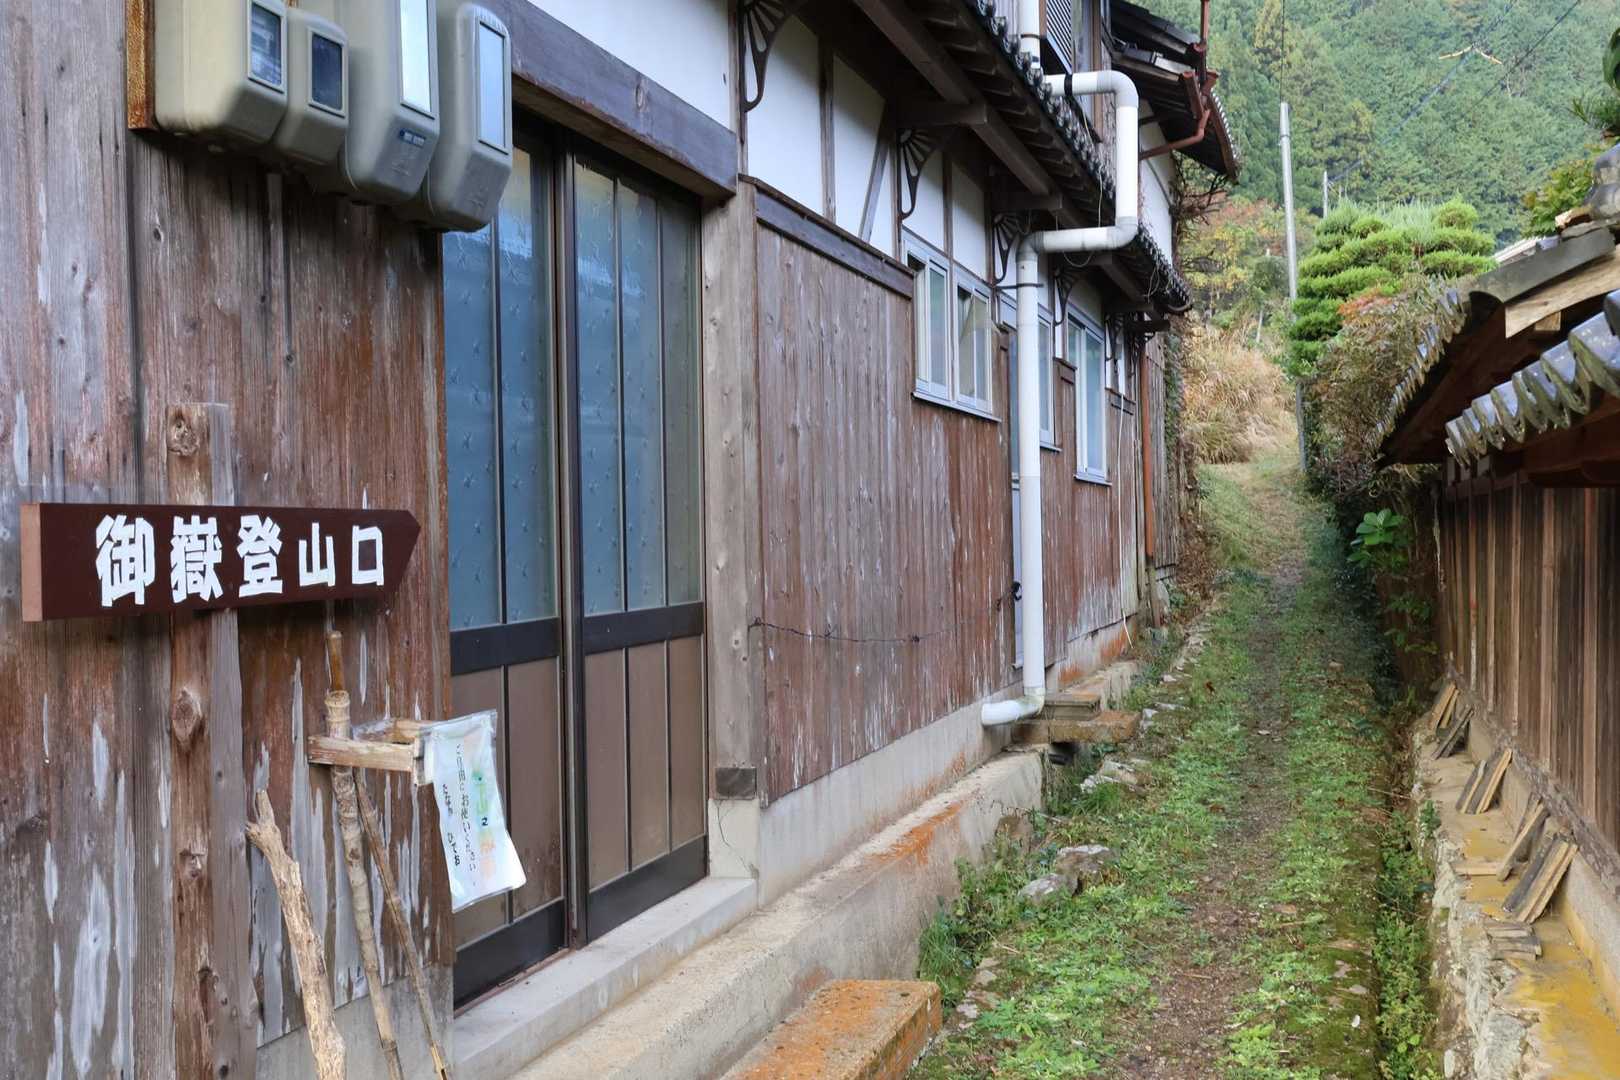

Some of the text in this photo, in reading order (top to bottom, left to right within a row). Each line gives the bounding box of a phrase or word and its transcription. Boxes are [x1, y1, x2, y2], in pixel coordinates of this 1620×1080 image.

[95, 514, 385, 607] 御嶽登山口
